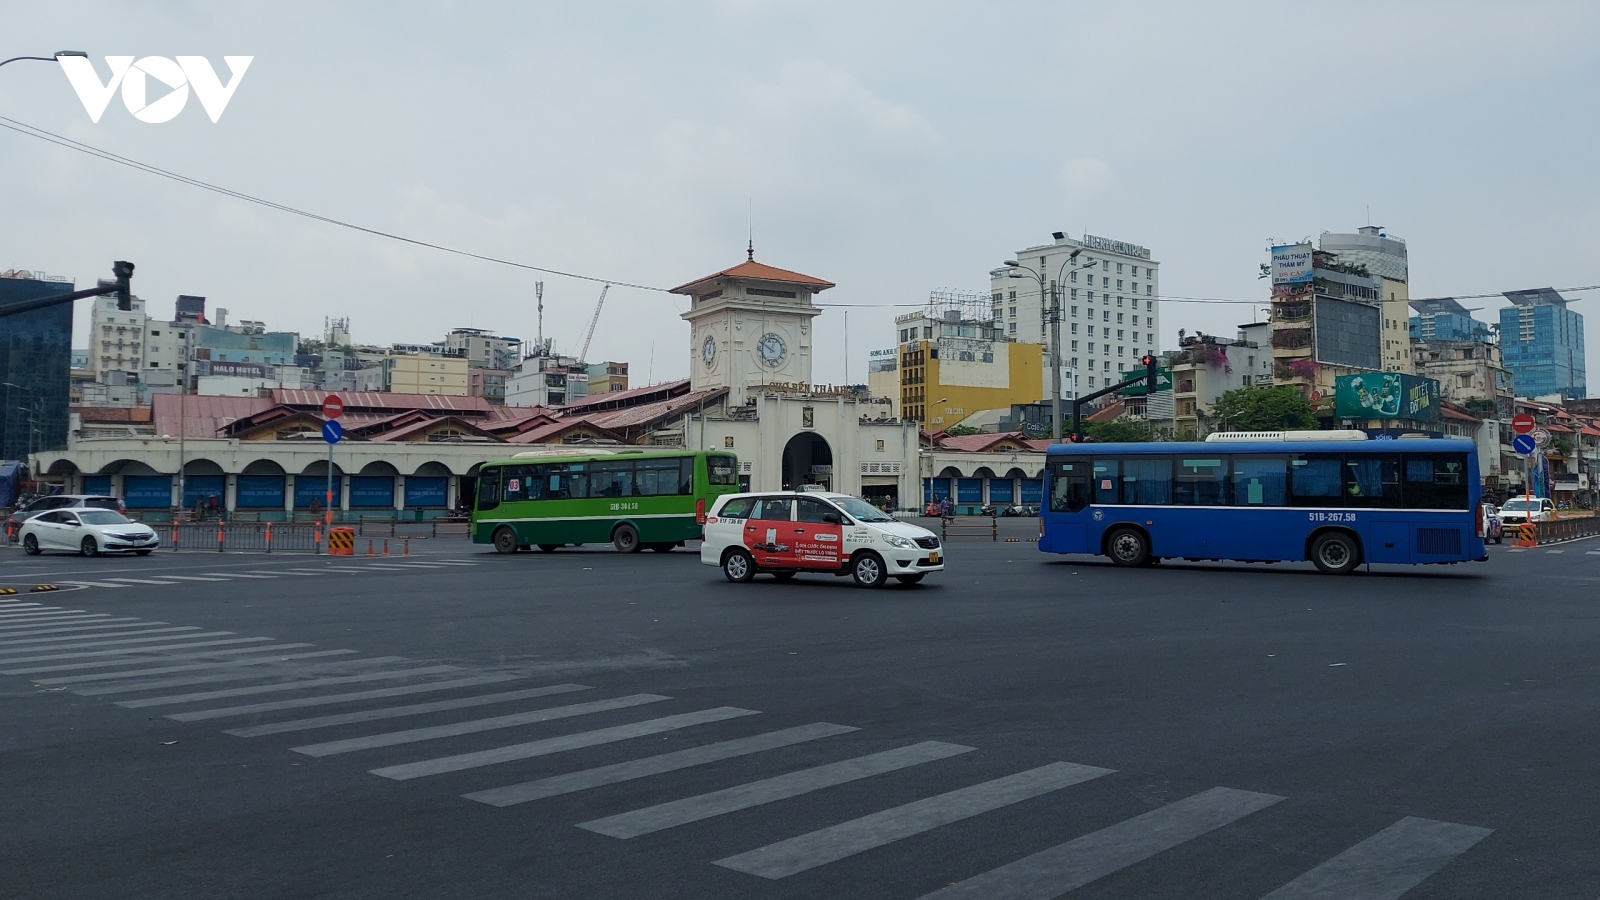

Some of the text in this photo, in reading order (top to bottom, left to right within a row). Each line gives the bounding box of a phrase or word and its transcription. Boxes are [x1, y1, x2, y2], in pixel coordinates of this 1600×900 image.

[791, 381, 810, 393] BẾN
[510, 481, 519, 489] 03
[1309, 512, 1356, 521] 51B-267.58
